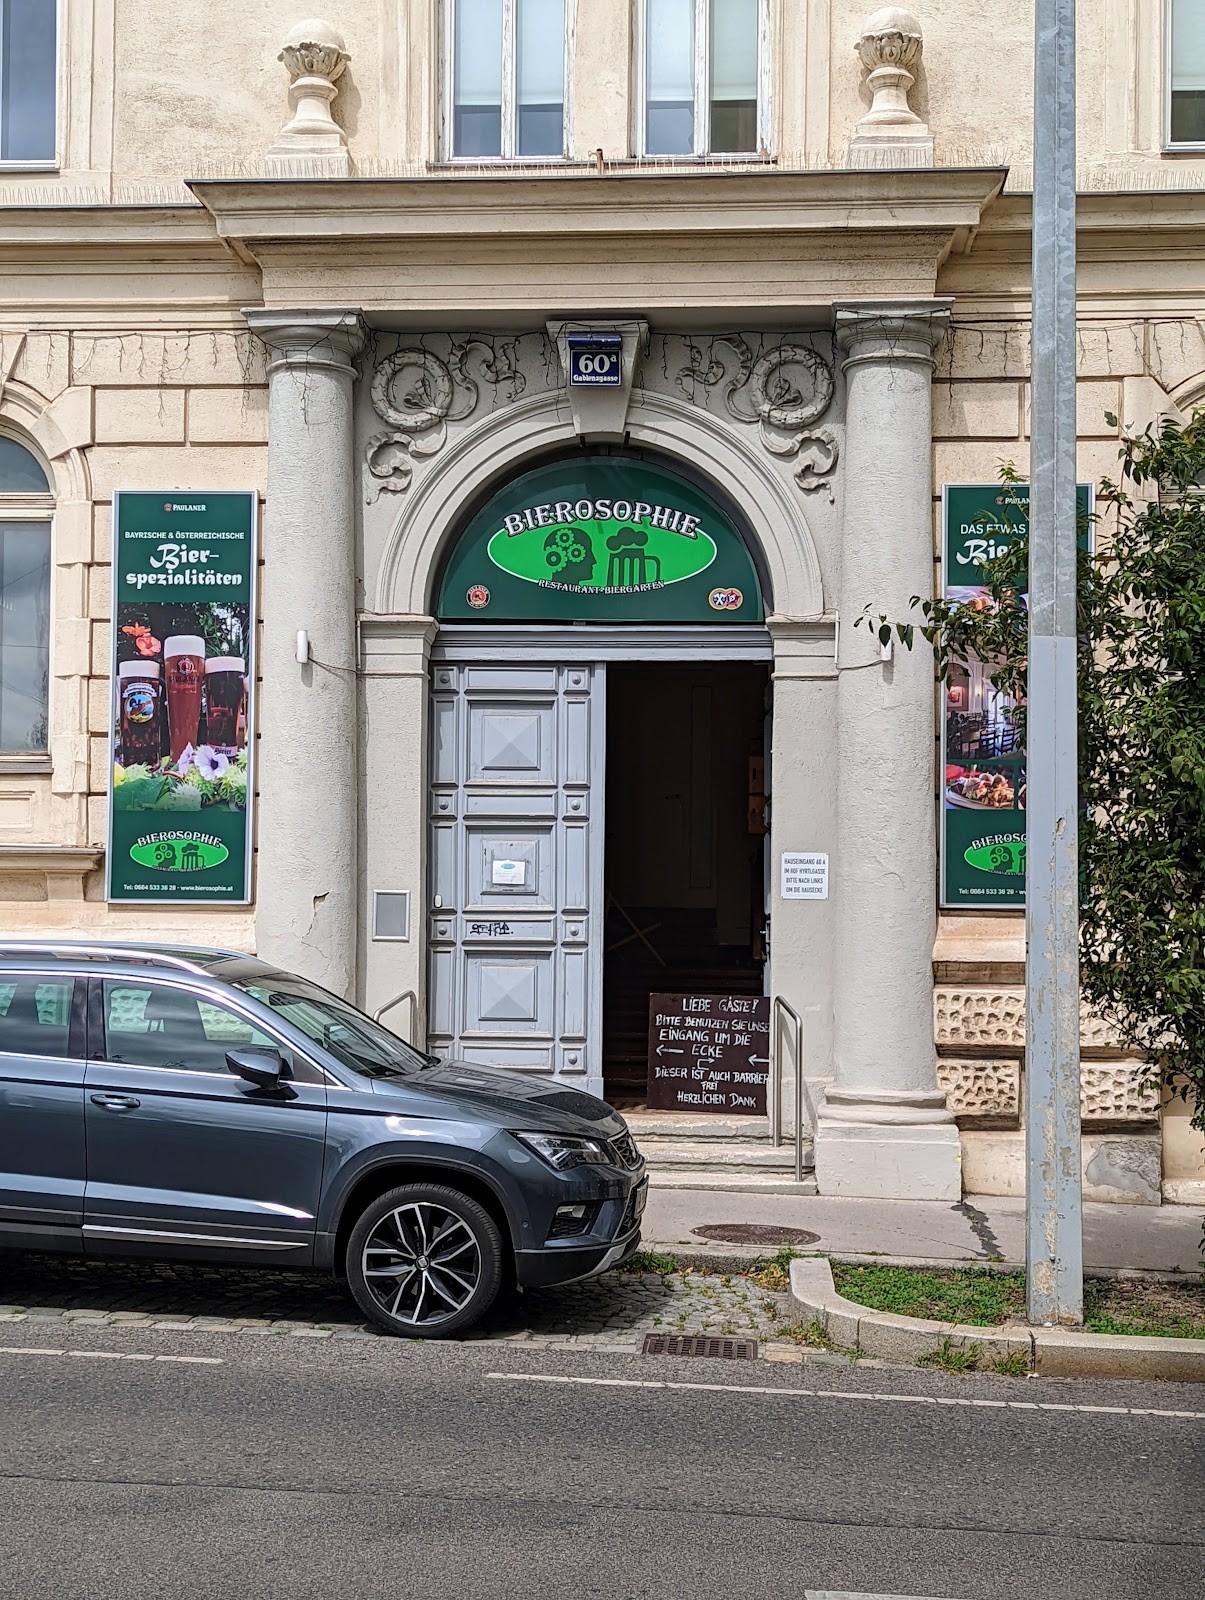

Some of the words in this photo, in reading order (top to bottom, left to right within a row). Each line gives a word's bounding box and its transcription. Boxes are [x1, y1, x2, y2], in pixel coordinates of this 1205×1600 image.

[173, 504, 206, 512] PAULANER
[503, 499, 702, 539] BIEROSOPHIE
[125, 531, 166, 539] BAYRISCHE
[176, 530, 244, 539] ÖSTERREICHISCHE
[960, 524, 984, 535] DAS
[986, 523, 1026, 534] ETWAS
[150, 543, 219, 570] Bier-
[956, 538, 1012, 566] Bie
[126, 569, 242, 589] spezialitäten
[538, 579, 600, 594] RESTAURANT
[604, 580, 665, 594] BIERGARTEN
[137, 831, 221, 848] BIEROSOPHIE
[971, 833, 1026, 850] BIEROSO
[682, 996, 712, 1013] LIEBE
[655, 1014, 682, 1026] BITTE
[684, 1016, 728, 1030] BENUTZEN
[731, 1019, 748, 1031] SIE
[748, 1021, 769, 1033] UNSE
[660, 1026, 709, 1042] EINGANG
[715, 1032, 731, 1046] UM
[733, 1032, 752, 1046] DIE
[692, 1043, 723, 1058] ECKE
[655, 1066, 688, 1079] DIESER
[708, 1070, 730, 1082] AUCH
[732, 1071, 769, 1085] BARRIER
[700, 1080, 719, 1091] FREI
[677, 1090, 726, 1105] HERZLICHEN
[729, 1092, 757, 1108] DANK
